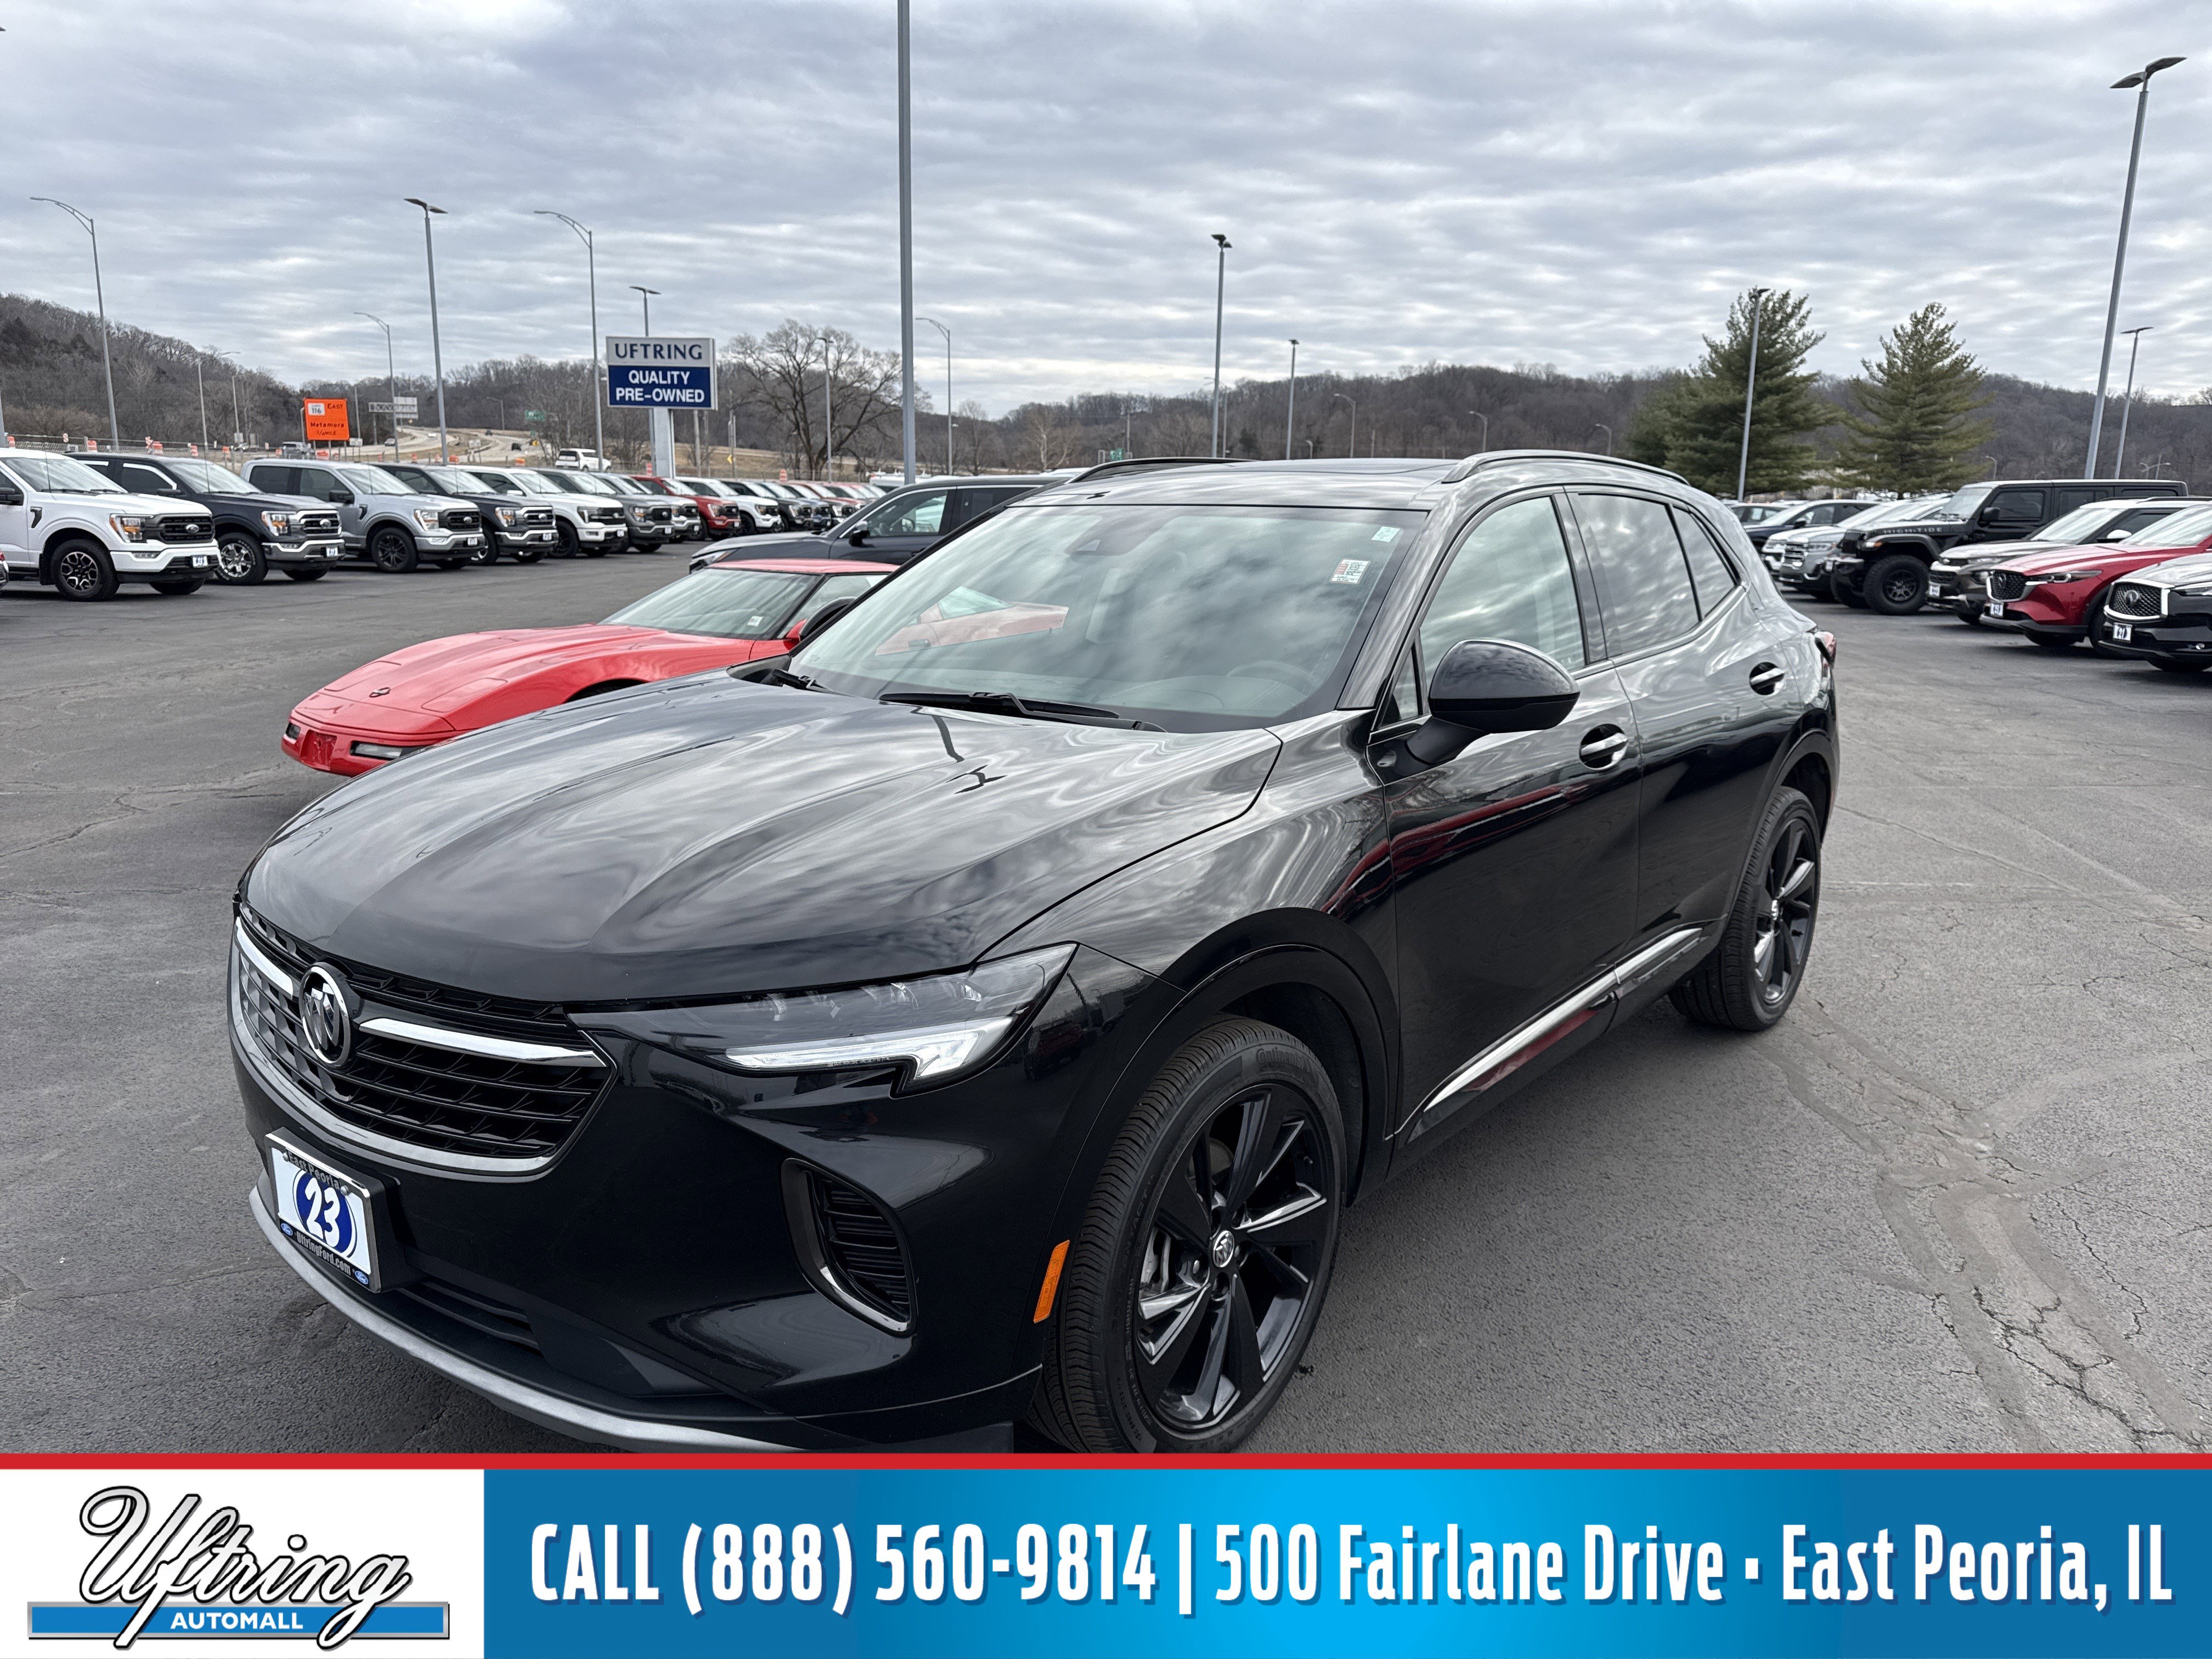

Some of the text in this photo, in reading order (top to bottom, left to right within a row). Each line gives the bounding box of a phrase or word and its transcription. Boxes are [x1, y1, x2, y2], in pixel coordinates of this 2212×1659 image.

[614, 343, 702, 360] UFTRING
[628, 370, 691, 385] QUALITY
[615, 387, 705, 403] PRE-OWNED
[1255, 1046, 1306, 1070] Continental
[288, 1152, 340, 1190] East Peoria
[304, 1177, 341, 1248] 23
